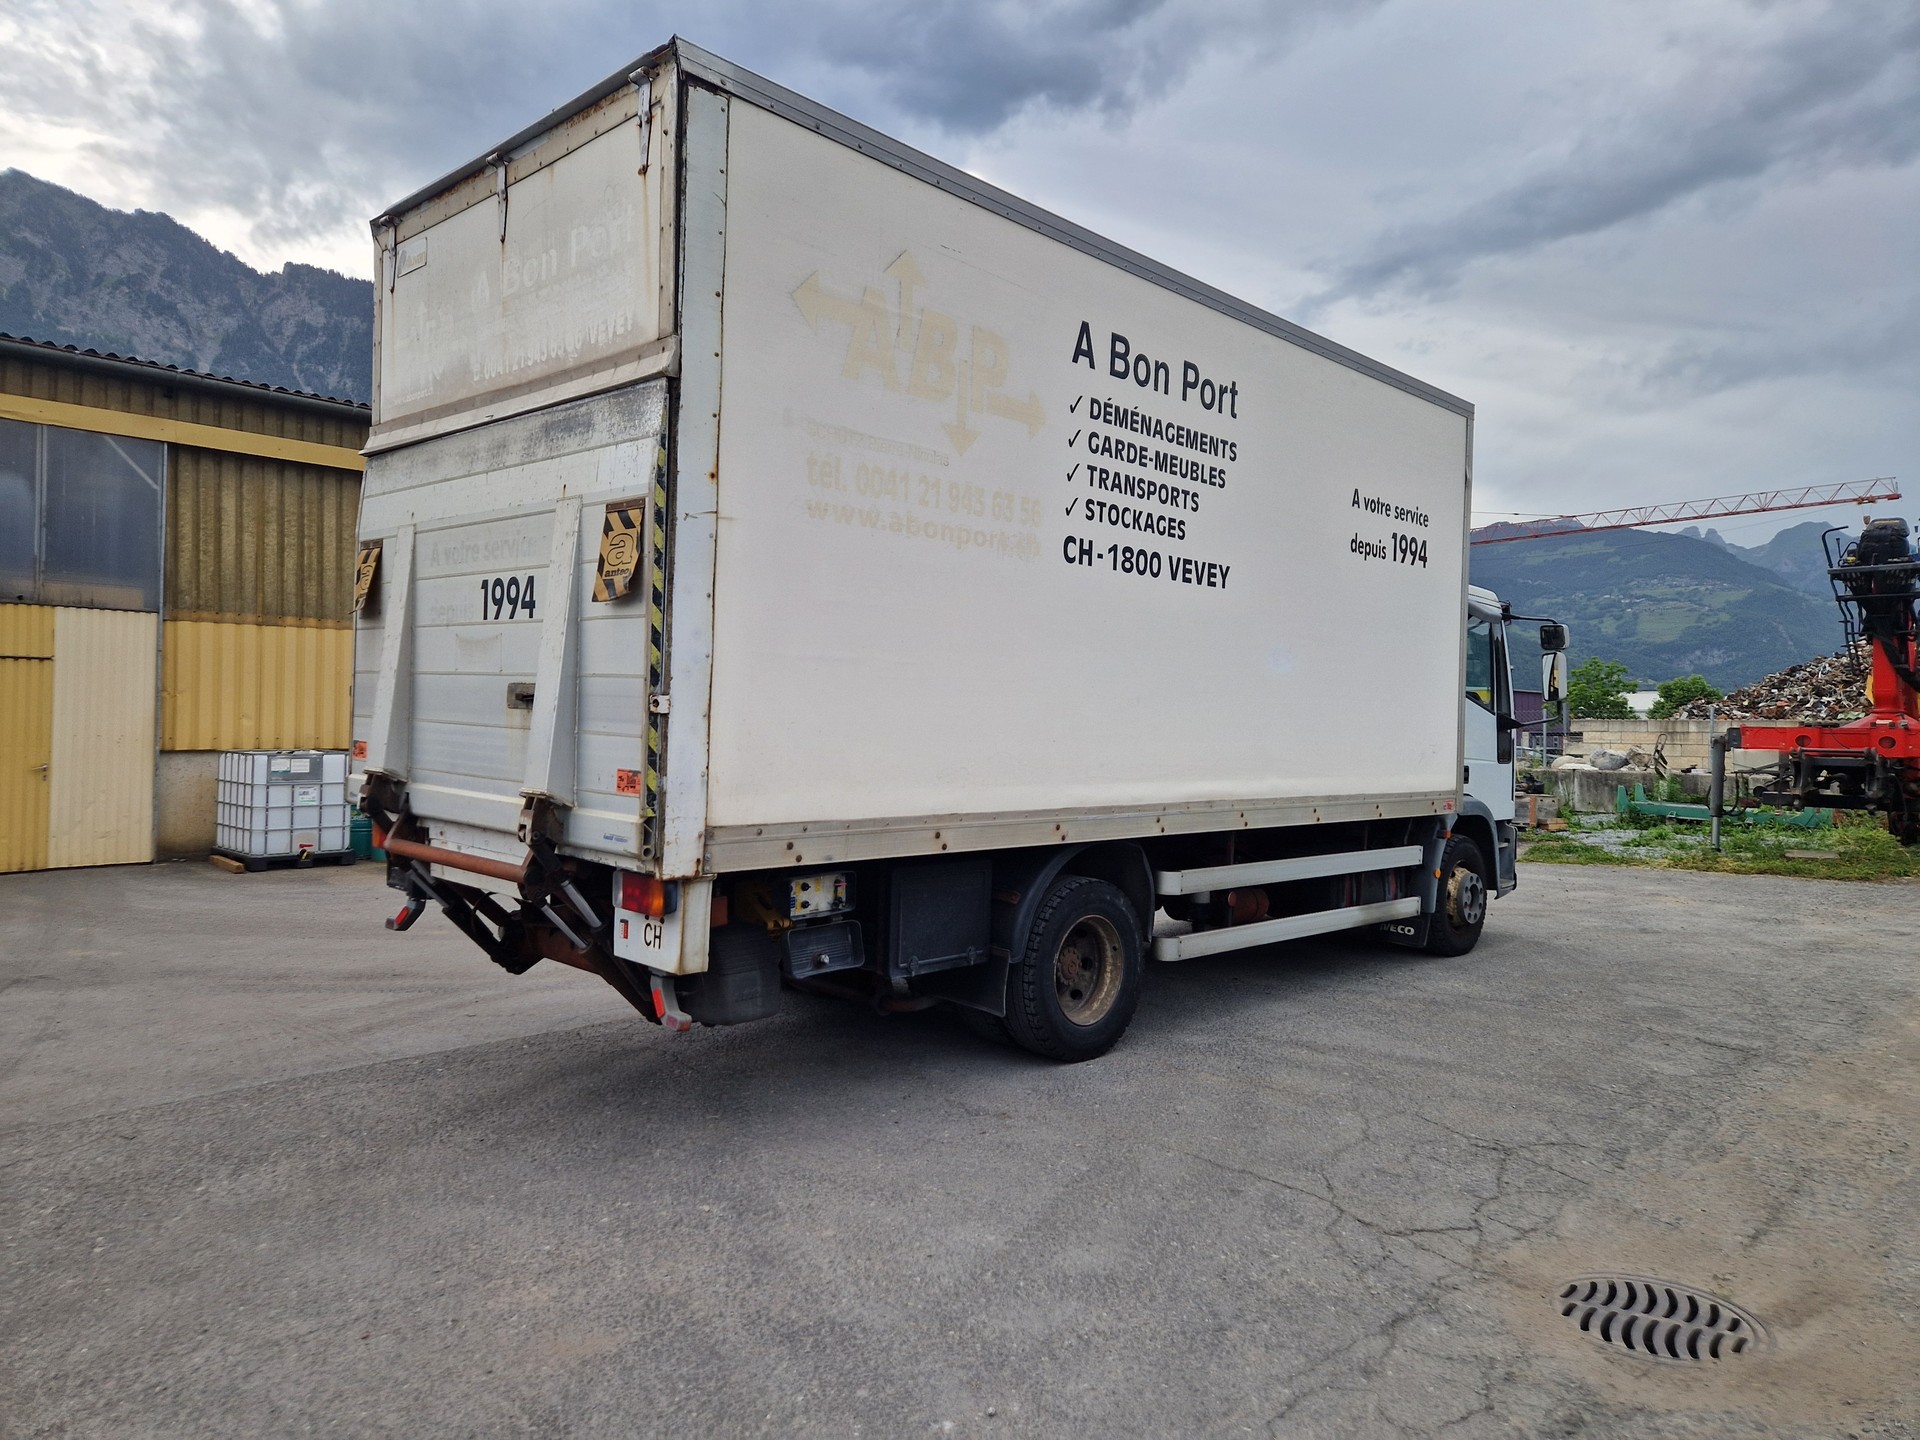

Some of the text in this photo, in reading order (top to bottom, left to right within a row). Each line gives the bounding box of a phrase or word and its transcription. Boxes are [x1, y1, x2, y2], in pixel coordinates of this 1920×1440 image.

[1072, 320, 1239, 419] A Bon Port
[1089, 397, 1238, 462] DÉMÉNAGEMENTS
[1088, 432, 1226, 489] GARDE-MEUBLES
[1087, 464, 1200, 512] TRANSPORTS
[1351, 488, 1429, 528] A votre service
[1085, 498, 1186, 541] STOCKAGES
[1168, 555, 1230, 589] VEVEY
[1350, 532, 1428, 569] depuis 1994
[480, 575, 537, 621] 1994
[644, 922, 662, 949] CH
